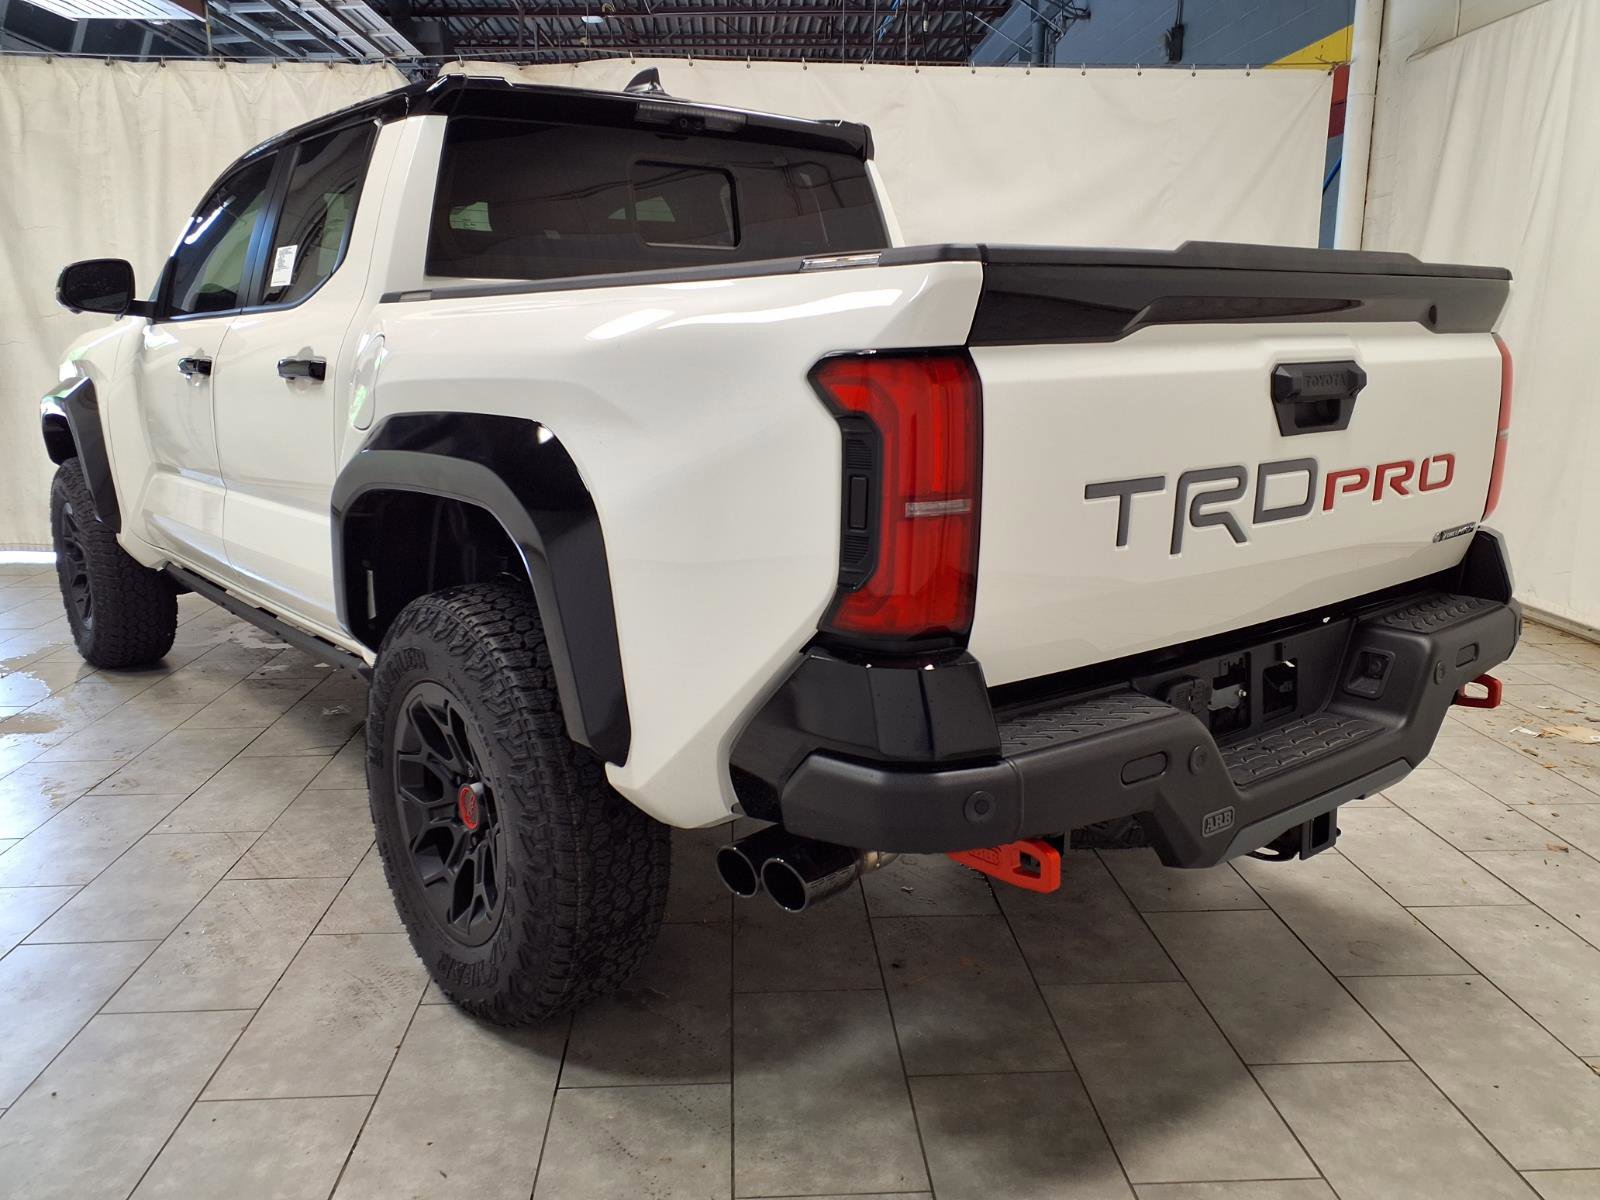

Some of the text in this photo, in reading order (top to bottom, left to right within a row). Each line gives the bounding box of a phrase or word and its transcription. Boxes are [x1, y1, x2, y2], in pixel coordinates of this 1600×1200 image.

[1304, 373, 1347, 389] TOYOTA
[1084, 453, 1455, 555] TRD PRO
[1205, 811, 1232, 833] ARB
